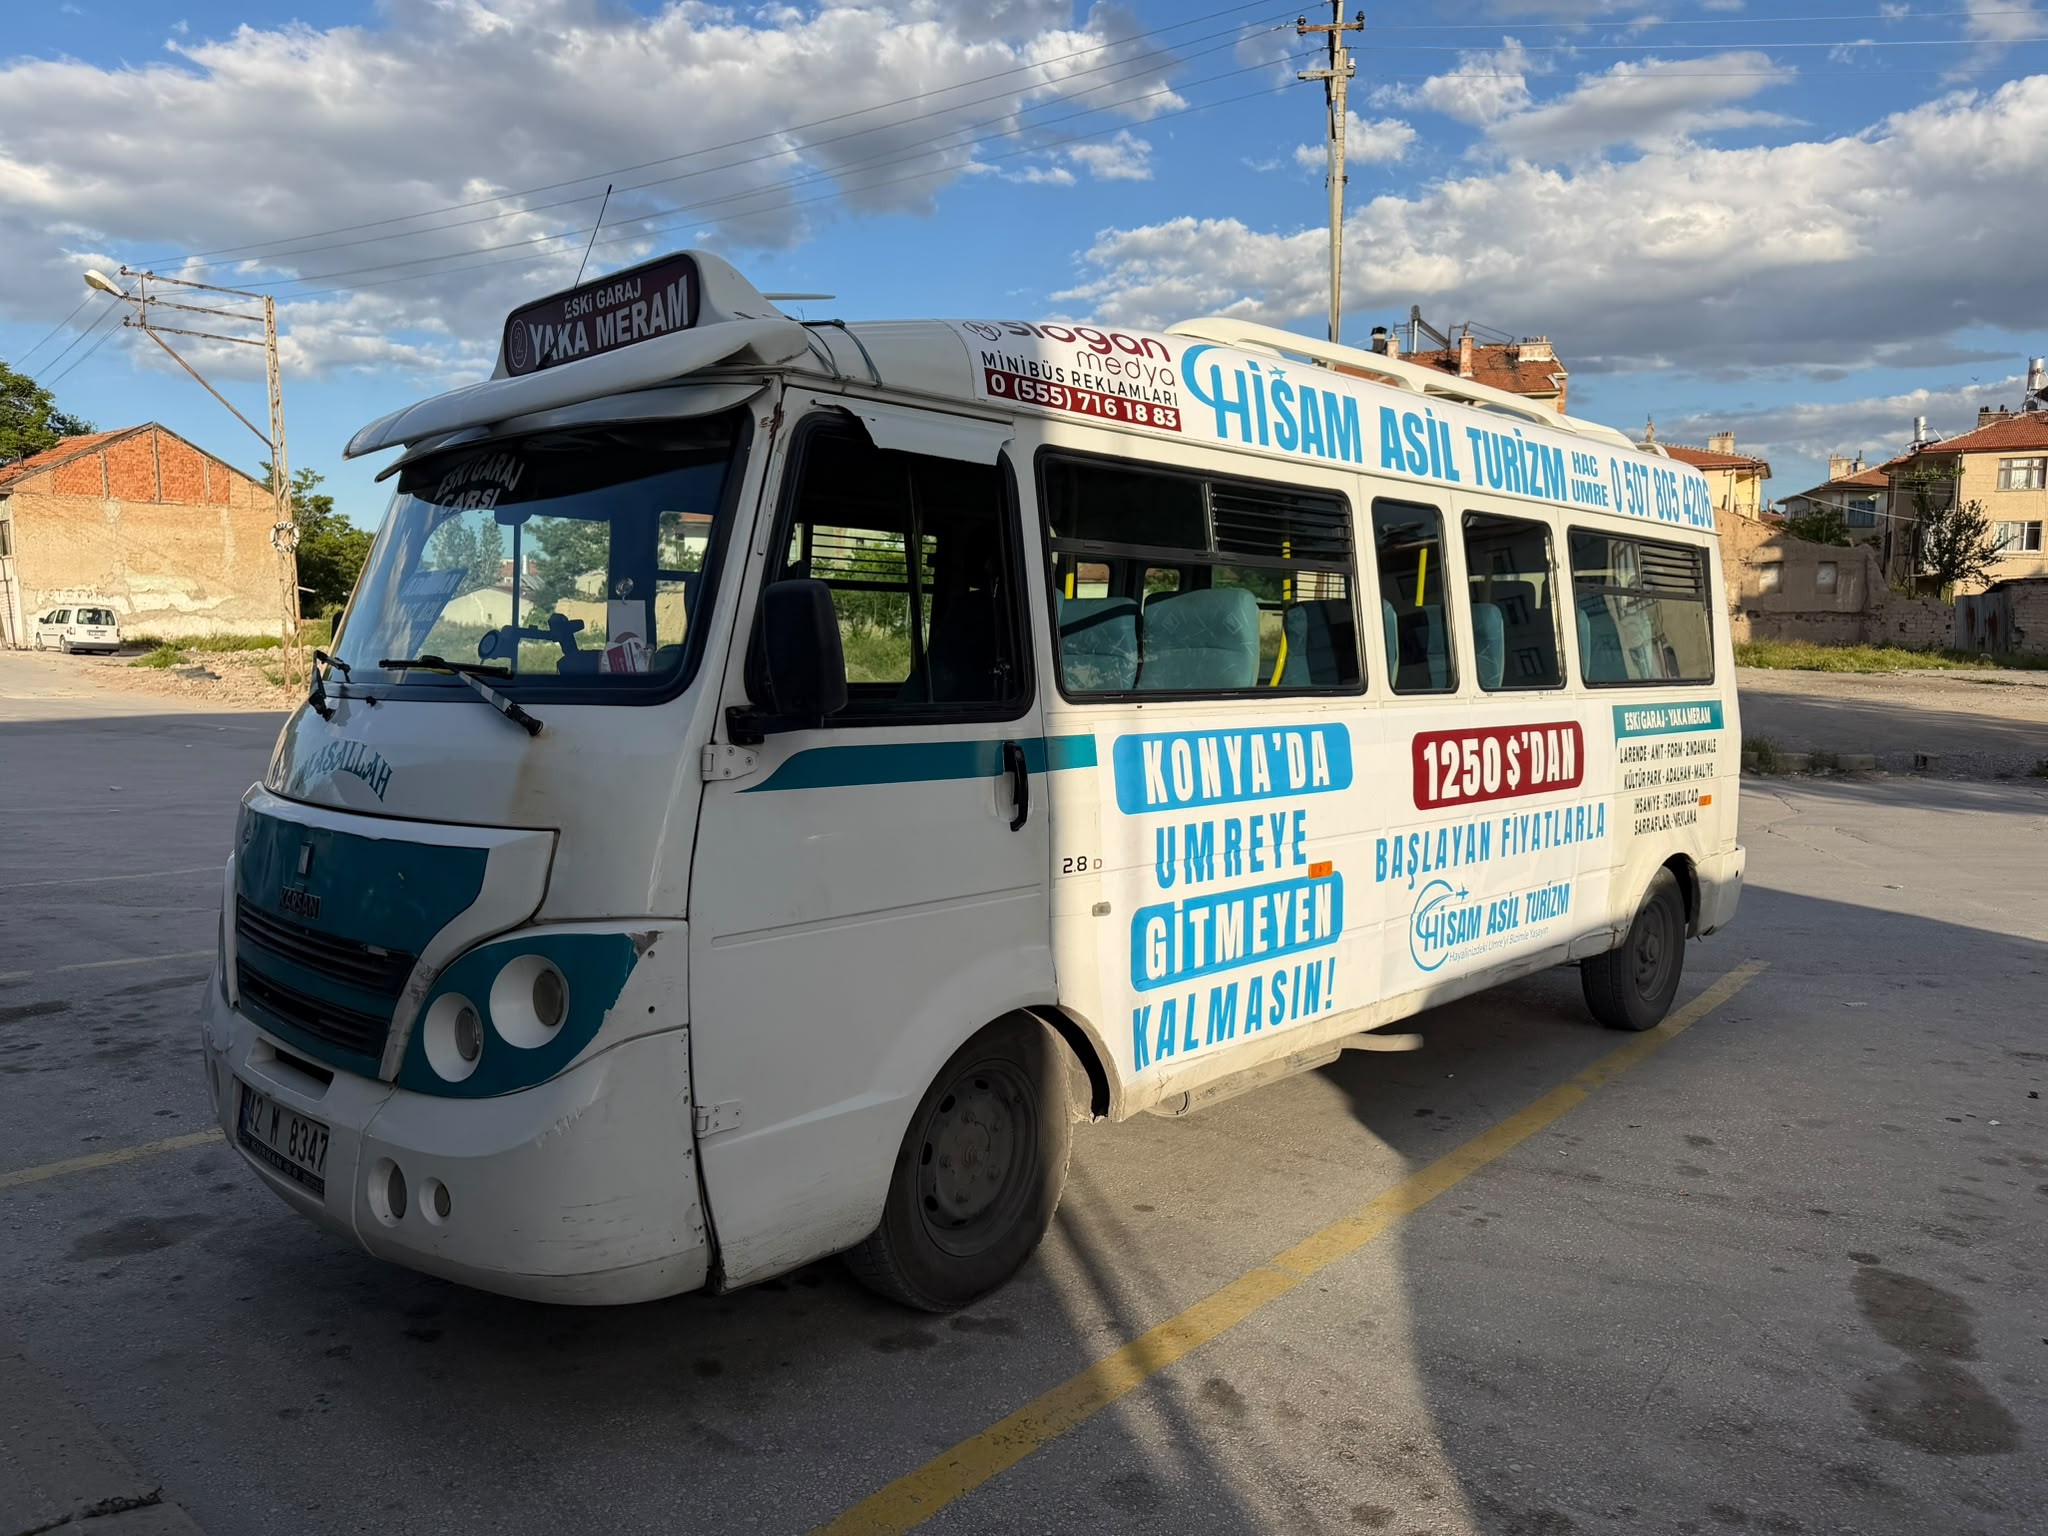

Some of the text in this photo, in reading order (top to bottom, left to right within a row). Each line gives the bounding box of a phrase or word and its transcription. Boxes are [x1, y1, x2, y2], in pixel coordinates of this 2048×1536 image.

[529, 321, 590, 365] YAKA
[596, 275, 688, 348] MERAM
[596, 278, 642, 309] GARAJ
[998, 321, 1171, 362] slogan
[981, 350, 1178, 406] MİNİBÜS REKLAMLARI
[1076, 351, 1176, 387] medya
[991, 374, 1177, 428] 0 (555) 716 18 83
[470, 453, 525, 492] GARAJ
[1379, 407, 1460, 482] ASİL
[1466, 427, 1567, 502] TURİZM
[1571, 451, 1598, 477] HAC
[1571, 478, 1609, 507] UMRE
[1610, 457, 1714, 529] 0 507 805 4206
[1641, 709, 1665, 729] GARAJ
[1668, 708, 1687, 726] YAKA
[1687, 707, 1711, 724] MERAM
[1423, 736, 1501, 801] 1250
[1620, 745, 1647, 764] LARENDE
[1650, 743, 1664, 760] ANIT
[1155, 809, 1307, 889] UMREYE
[1375, 802, 1605, 890] BAŞLAYAN FİYATLARLA
[1634, 814, 1672, 836] SARRAFLAR
[1063, 856, 1103, 874] 2.8 D
[280, 886, 321, 920] KARSAN
[1486, 892, 1519, 936] ASİL
[1525, 880, 1570, 924] TURİZM
[1145, 882, 1332, 981] GİTMEYEN
[1132, 957, 1336, 1072] KALMASIN!
[289, 1117, 329, 1172] 8347
